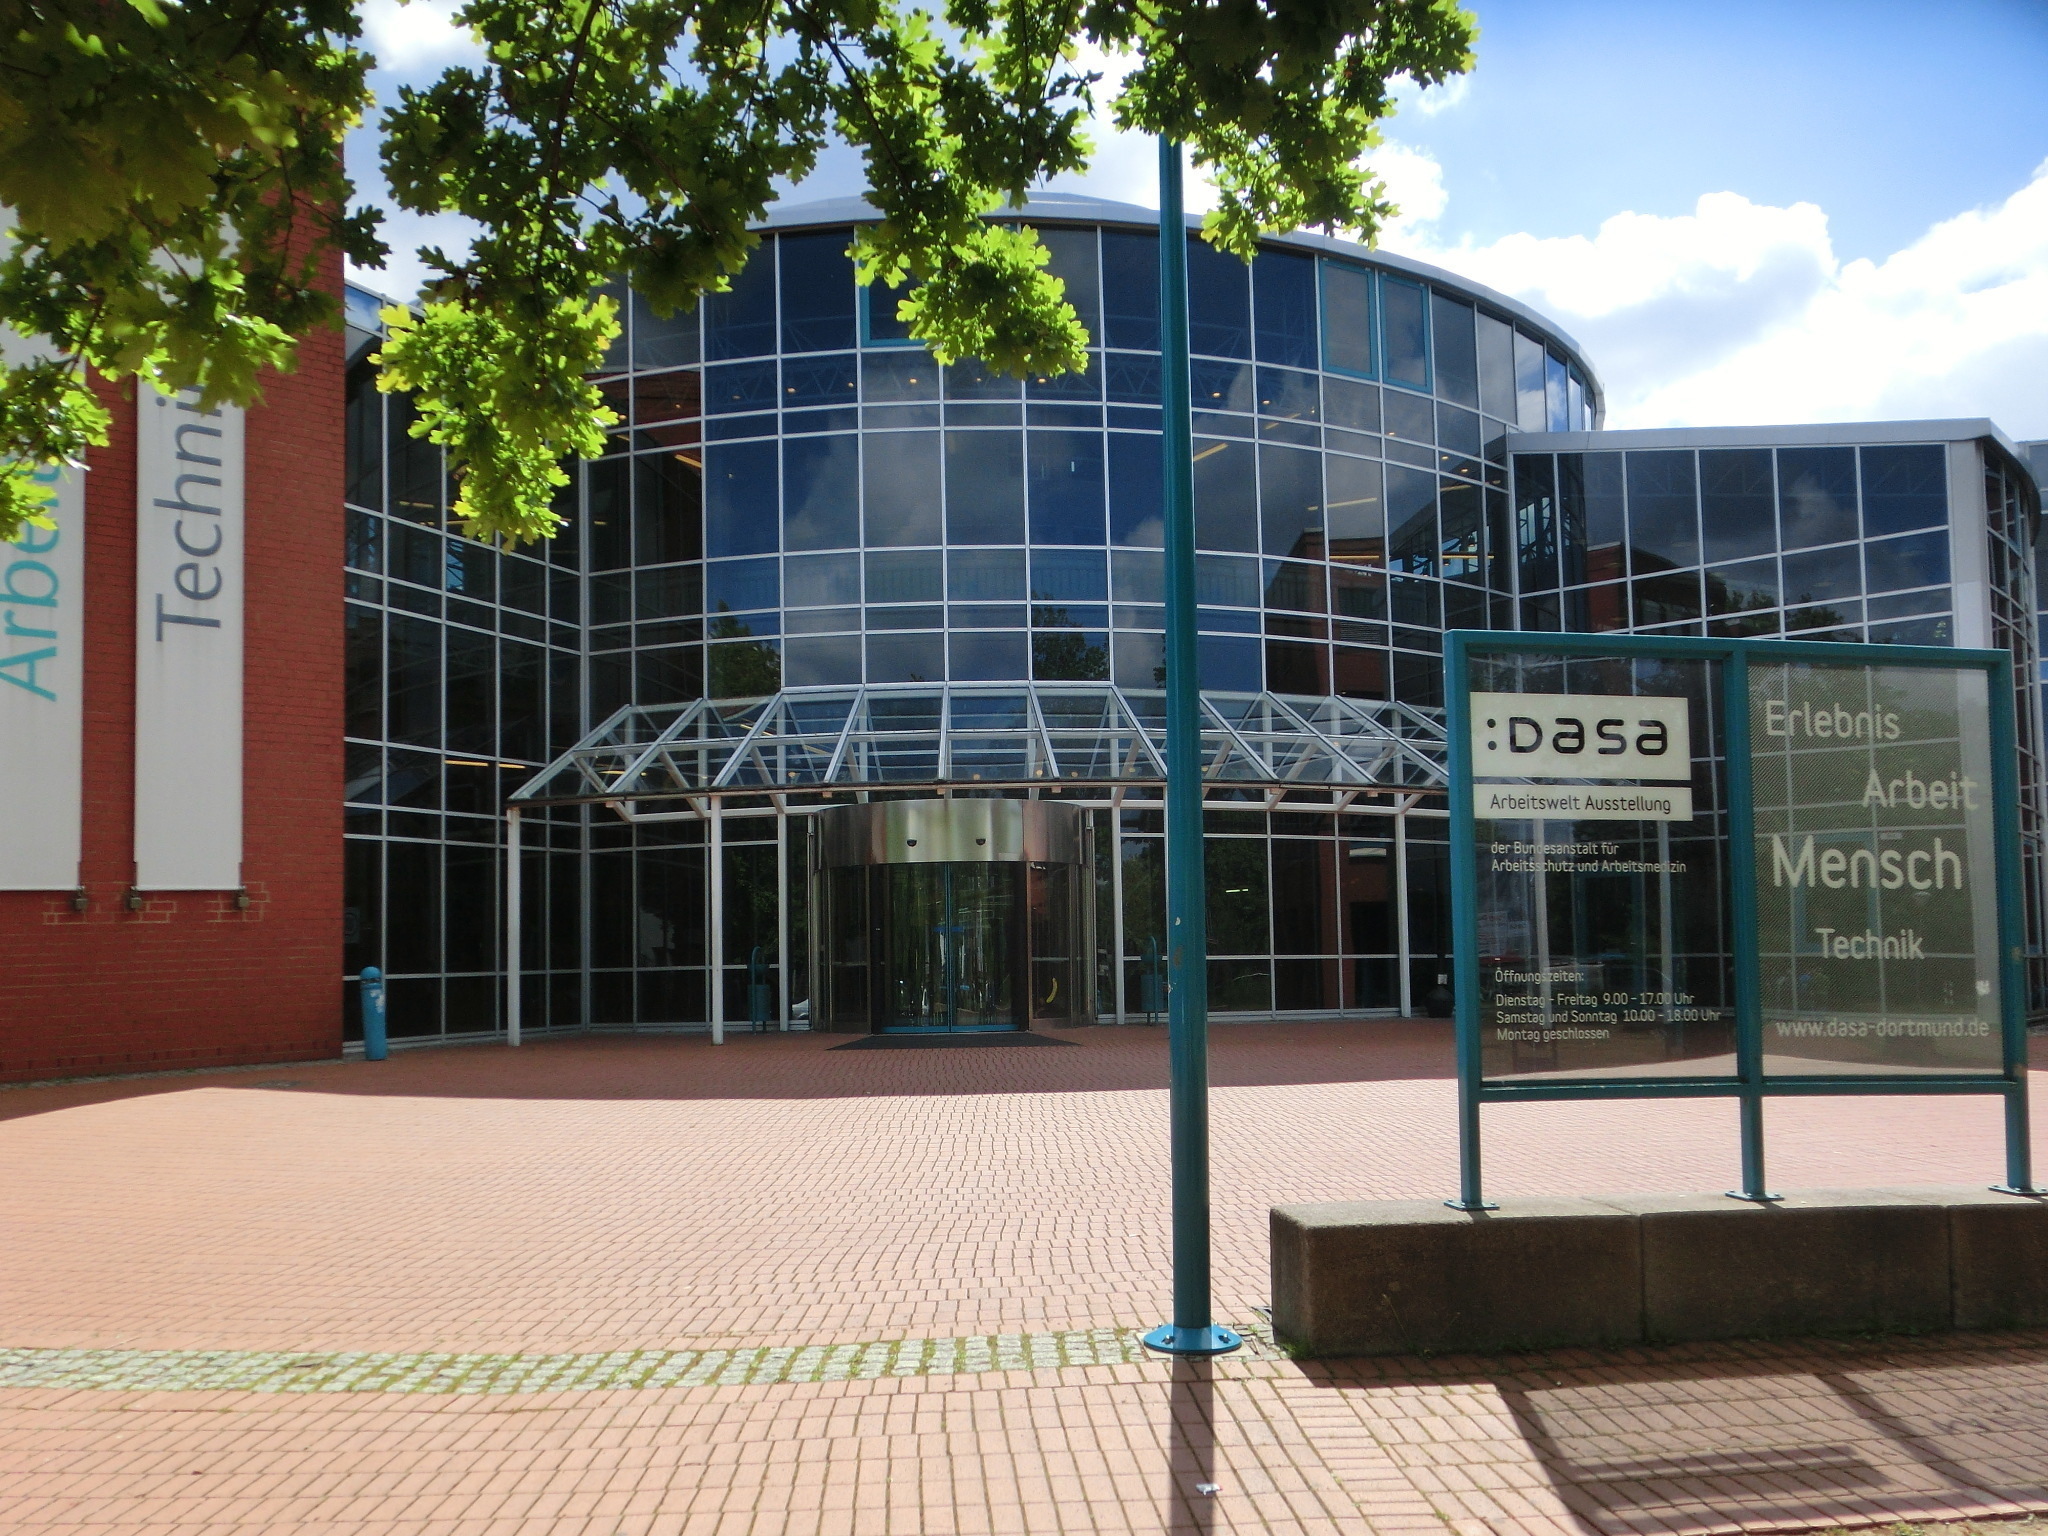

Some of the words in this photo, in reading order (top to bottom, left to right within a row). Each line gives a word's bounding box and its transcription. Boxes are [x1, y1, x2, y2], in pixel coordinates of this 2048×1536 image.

[1765, 700, 1901, 740] Erlebnis
[1862, 767, 1980, 811] Arbeit
[1490, 794, 1581, 811] Arbeitswelt
[1585, 795, 1672, 815] Ausstellung
[1491, 841, 1511, 855] der
[1513, 841, 1599, 856] Bundesanstalt
[1601, 842, 1620, 856] für
[1491, 859, 1575, 873] Arbeitsschutz
[1577, 860, 1600, 873] und
[1601, 860, 1687, 874] Arbeitsmedizin
[1771, 833, 1963, 891] Mensch
[1814, 927, 1926, 960] Technik
[1495, 966, 1585, 985] Öffnungszeiten:
[1496, 994, 1546, 1009] Dienstag
[1557, 993, 1598, 1008] Freitag
[1603, 992, 1629, 1006] 9.00
[1639, 992, 1672, 1005] 17.00
[1674, 992, 1696, 1005] Uhr
[1496, 1011, 1546, 1027] Samstag
[1549, 1011, 1568, 1024] und
[1571, 1011, 1618, 1025] Sonntag
[1623, 1009, 1656, 1022] 10.00
[1667, 1009, 1699, 1022] 18.00
[1701, 1009, 1722, 1022] Uhr
[1775, 1017, 1990, 1039] www.dasa-dortmund.de
[1496, 1028, 1541, 1043] Montag
[1543, 1027, 1610, 1042] geschlossen
